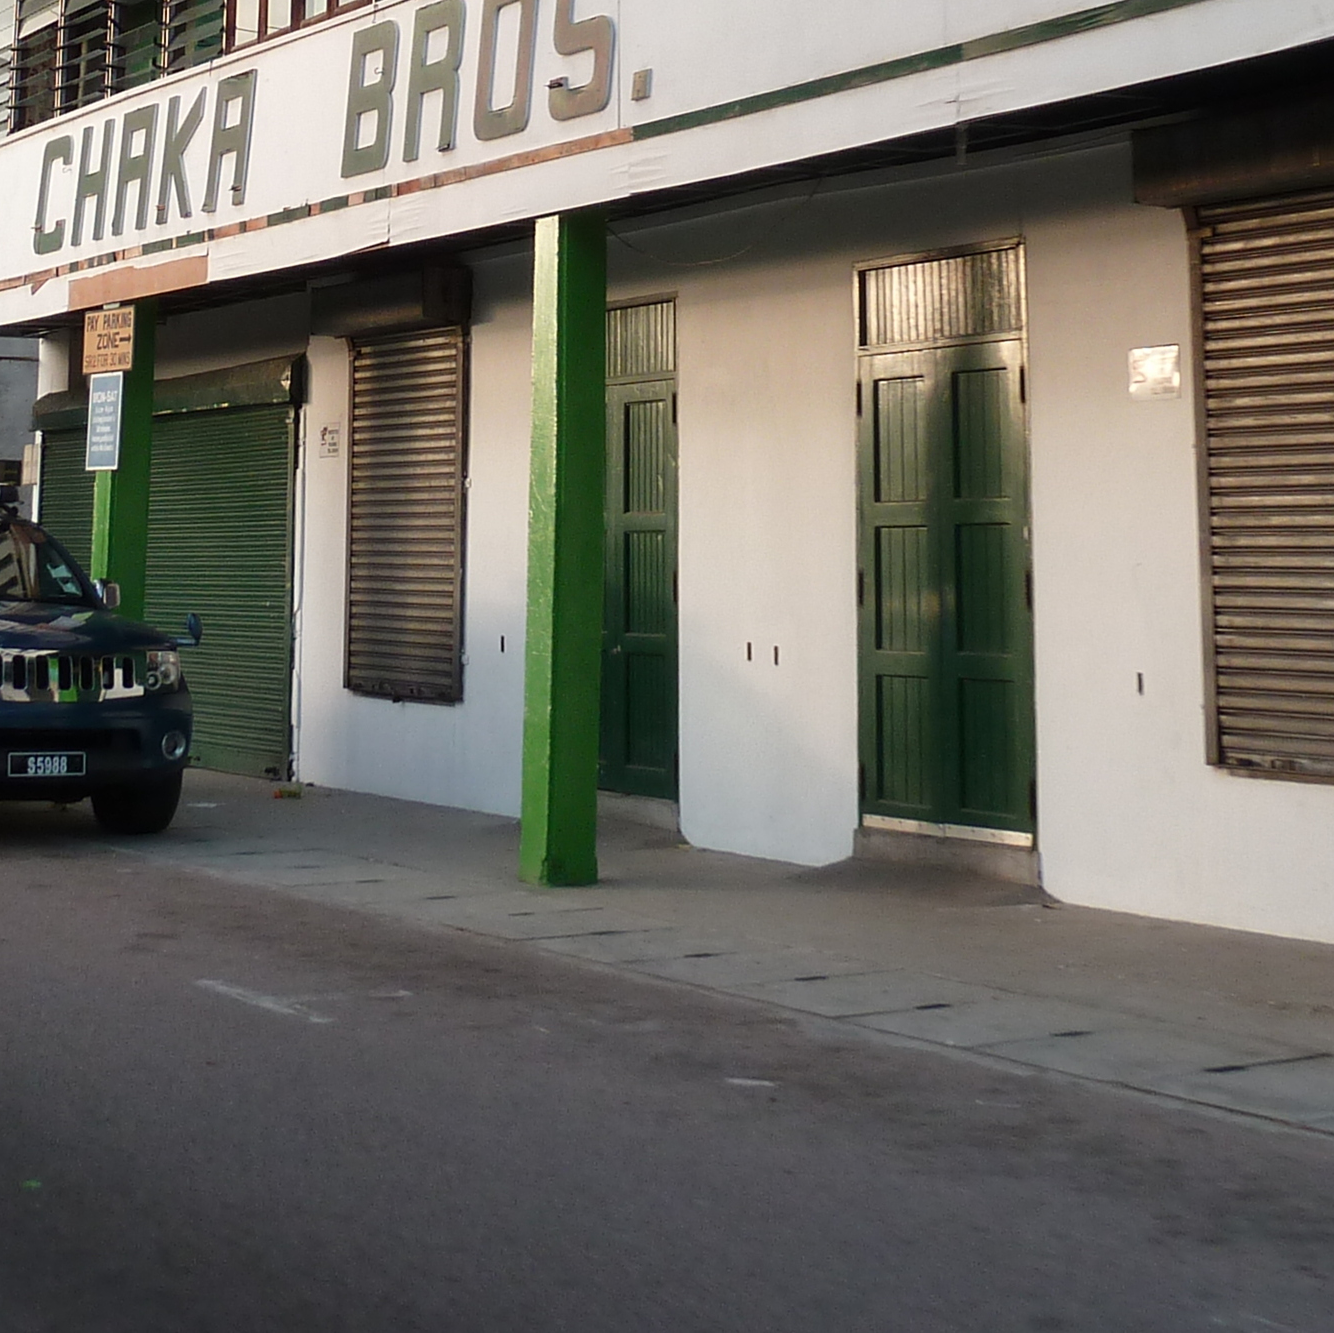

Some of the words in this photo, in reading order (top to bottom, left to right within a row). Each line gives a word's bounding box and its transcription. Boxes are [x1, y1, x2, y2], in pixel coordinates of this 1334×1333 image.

[33, 69, 258, 254] CHAKA
[87, 315, 99, 332] PAY
[103, 311, 132, 330] PARKING
[97, 332, 120, 350] ZONE
